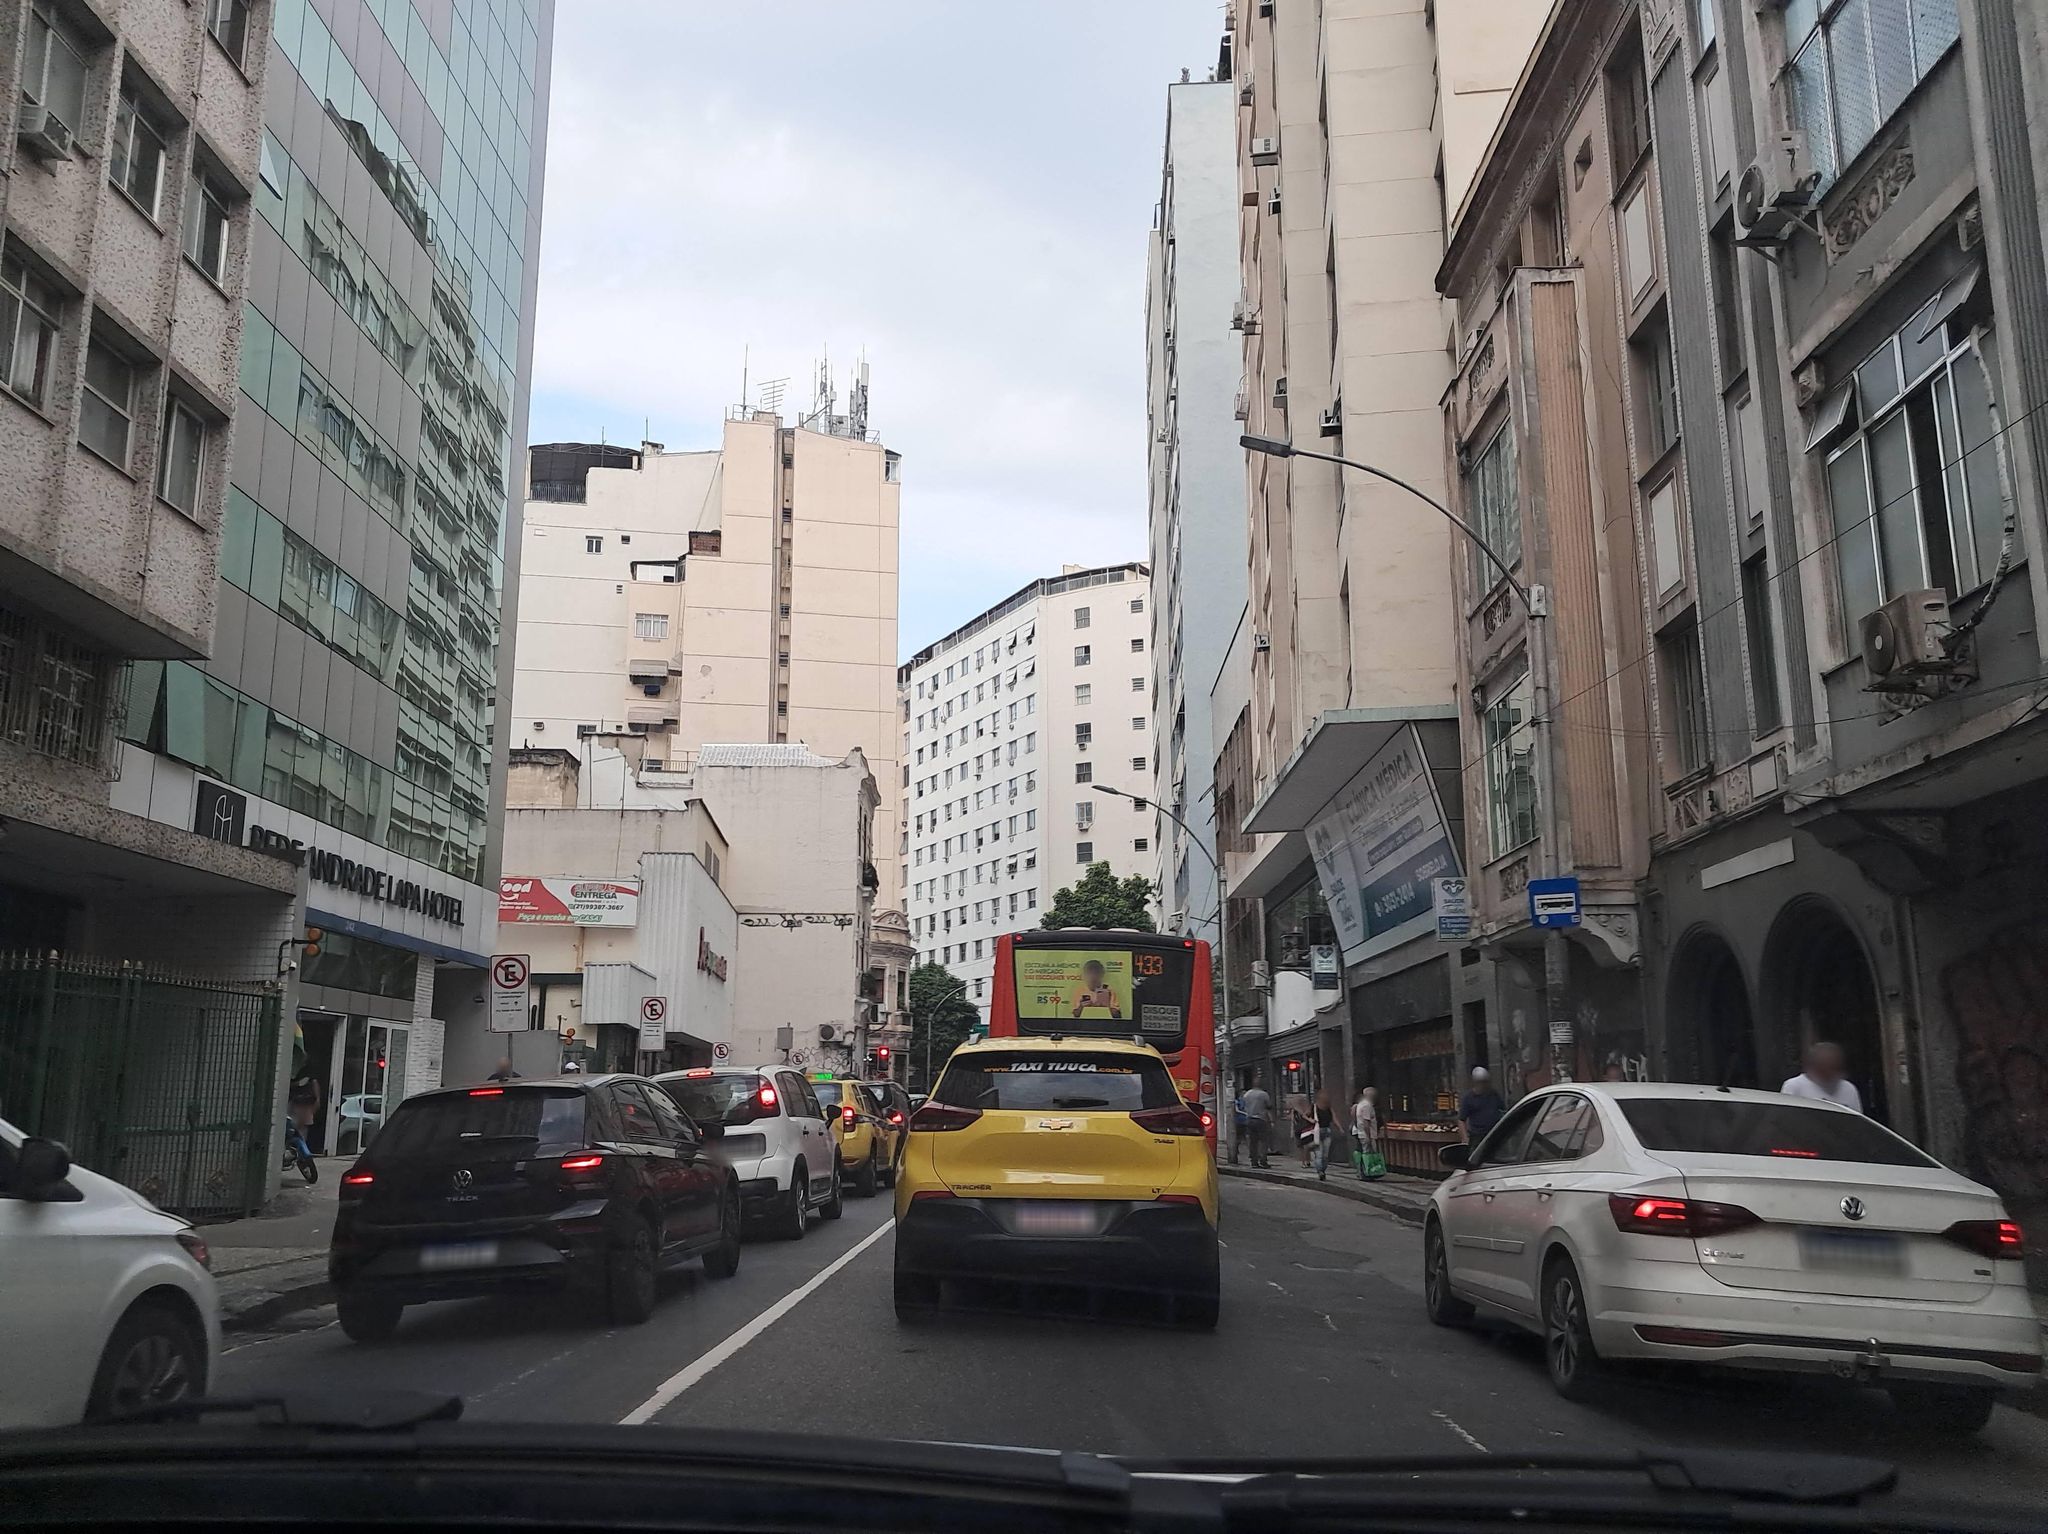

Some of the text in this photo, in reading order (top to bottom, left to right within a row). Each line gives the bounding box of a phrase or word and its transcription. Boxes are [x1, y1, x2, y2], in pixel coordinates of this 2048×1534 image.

[1376, 749, 1415, 800] MÉDICA
[308, 846, 387, 901] ANDRADE
[386, 874, 421, 913] LAPA
[421, 887, 465, 927] HOTEL
[575, 891, 617, 899] ENTREGA
[1135, 955, 1163, 975] 433
[1049, 996, 1062, 1005] 99
[1143, 1006, 1179, 1015] DISQUE
